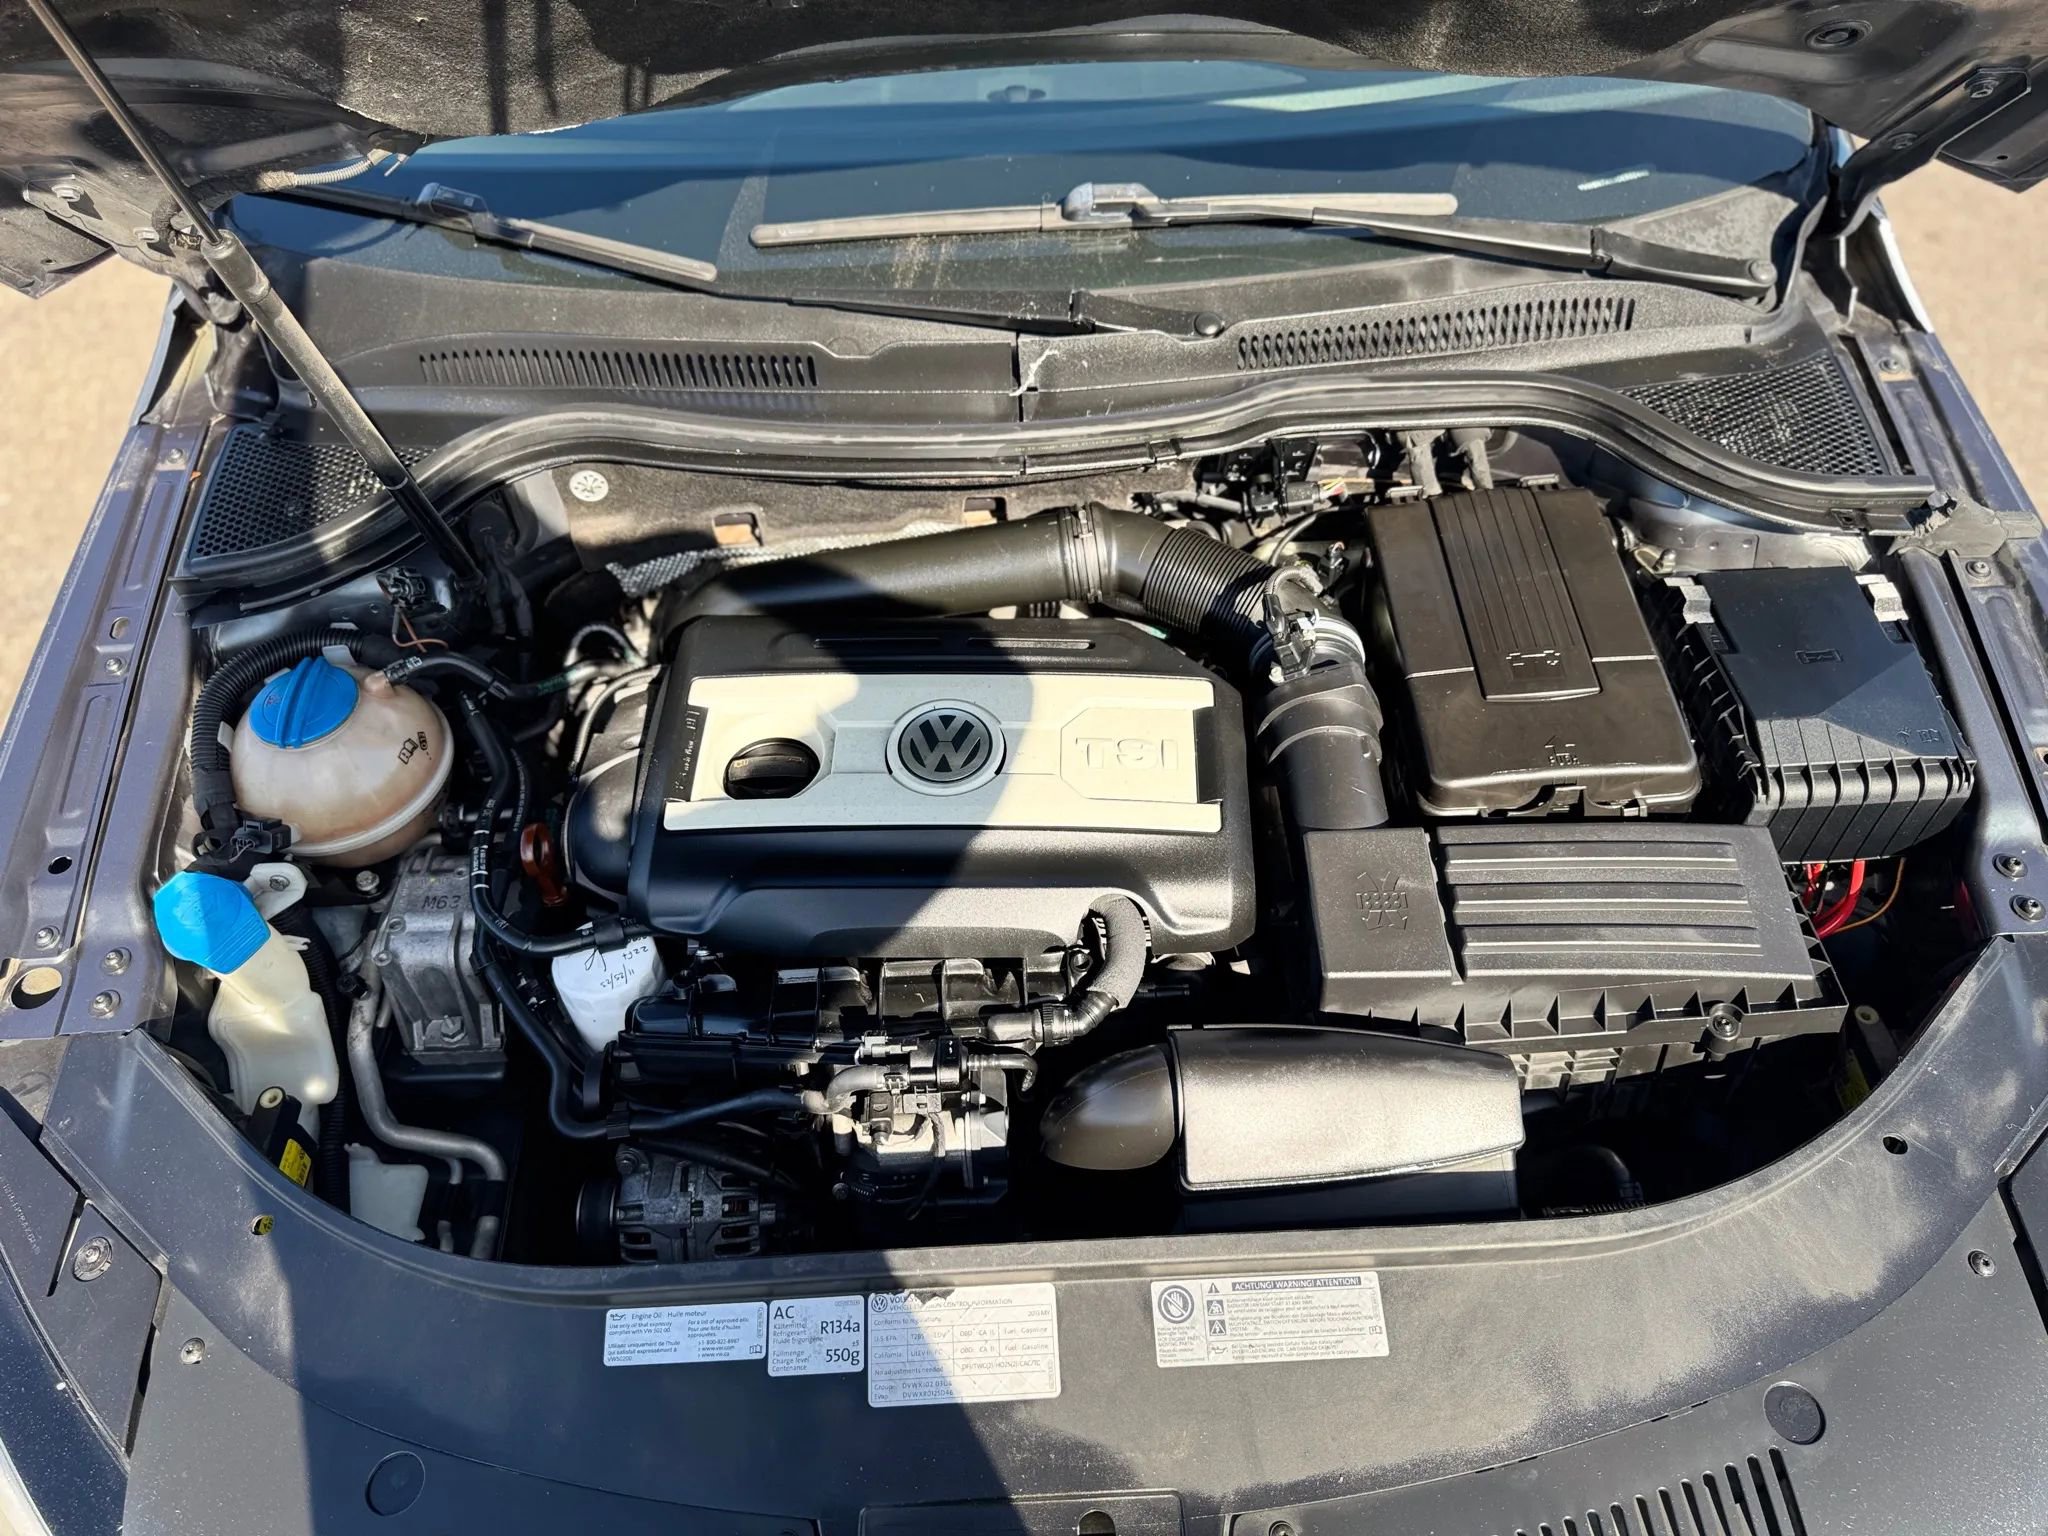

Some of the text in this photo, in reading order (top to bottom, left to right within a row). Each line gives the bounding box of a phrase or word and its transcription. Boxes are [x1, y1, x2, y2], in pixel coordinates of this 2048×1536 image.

[1075, 737, 1178, 769] TSI
[1234, 1277, 1360, 1290] ACHTUNG! WARNING! ATTENTION!
[632, 1313, 652, 1321] Engine
[773, 1305, 795, 1320] AC
[820, 1319, 860, 1335] R134a
[825, 1347, 860, 1366] 550g
[772, 1364, 807, 1372] Contenance
